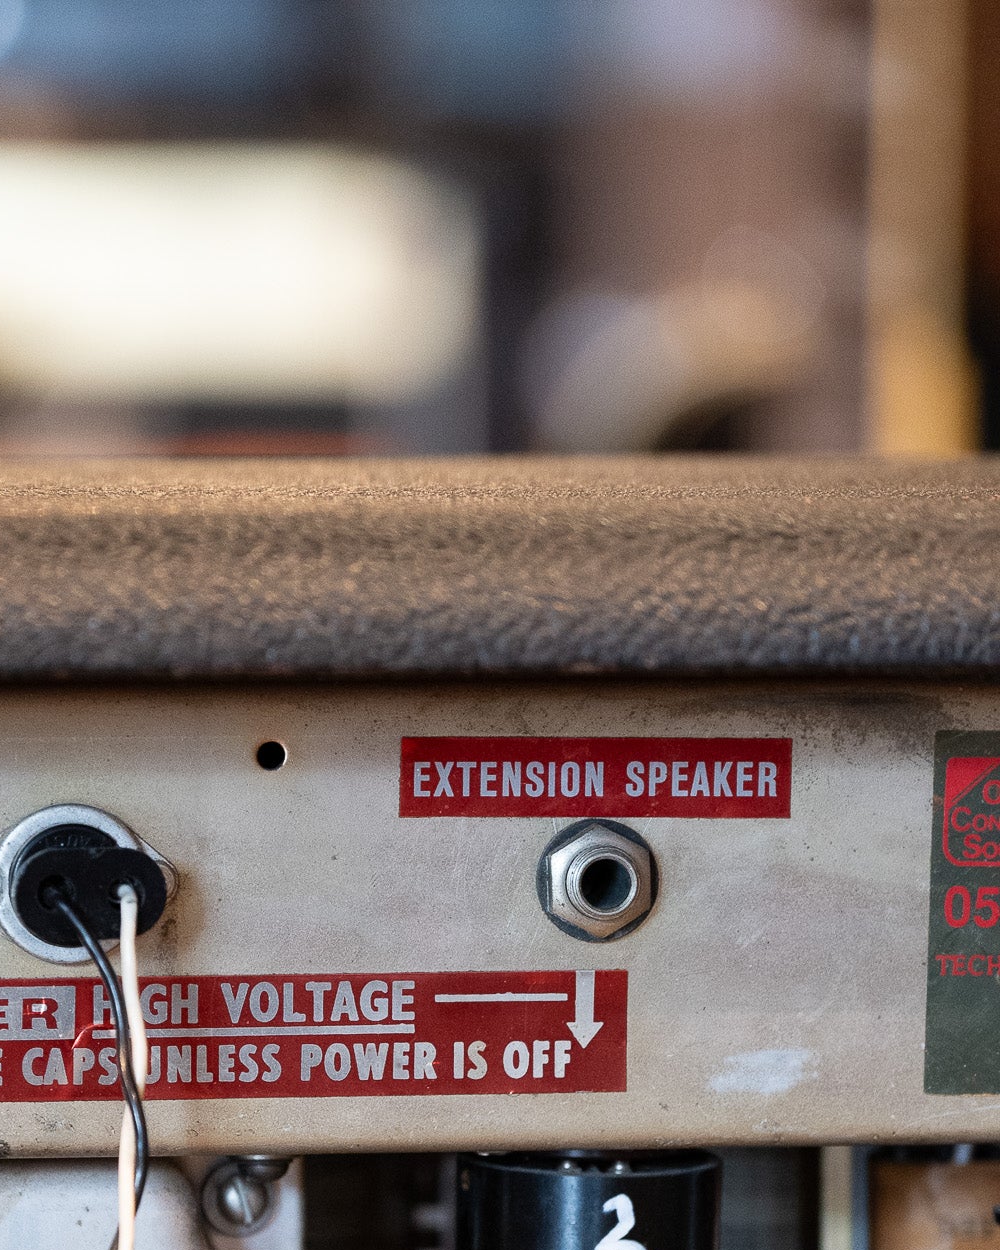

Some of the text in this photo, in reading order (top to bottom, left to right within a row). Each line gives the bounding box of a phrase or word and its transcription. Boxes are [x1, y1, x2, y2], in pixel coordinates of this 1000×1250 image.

[413, 761, 778, 798] EXTENSION SPEAKER
[944, 886, 1000, 929] 05
[92, 983, 199, 1025] HGH
[220, 980, 416, 1024] VOLTAGE
[21, 1047, 118, 1087] CAPS
[146, 1043, 282, 1084] UNLESS
[300, 1042, 438, 1082] POWER
[453, 1041, 488, 1080] IS
[502, 1040, 572, 1080] OFF
